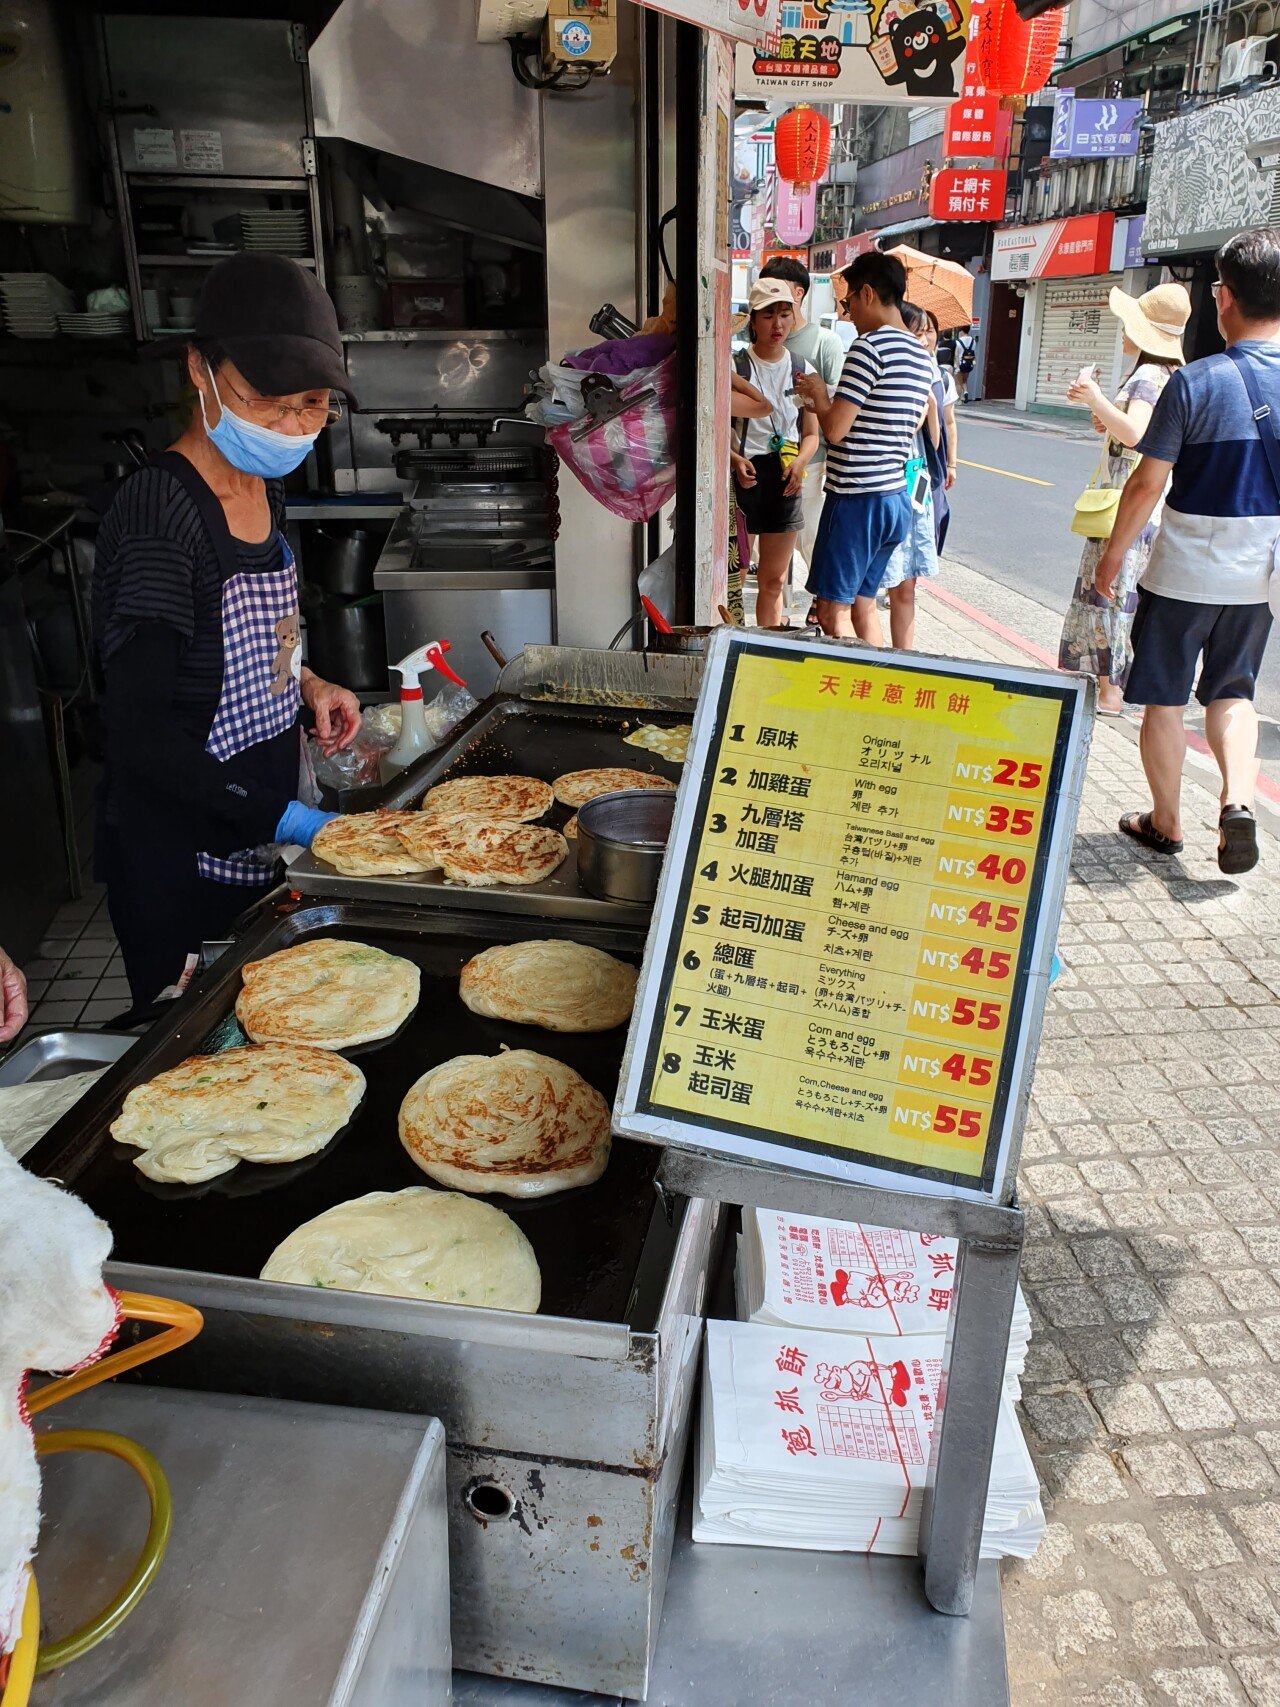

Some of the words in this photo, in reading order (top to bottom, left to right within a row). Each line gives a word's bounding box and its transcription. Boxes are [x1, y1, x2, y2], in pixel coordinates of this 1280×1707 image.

[803, 120, 818, 170] 人山人海
[950, 177, 992, 194] 上網卡
[949, 196, 990, 212] 預付卡
[818, 674, 971, 715] 天津蔥抓餅
[729, 725, 746, 742] 1
[756, 726, 799, 751] 原味
[862, 735, 901, 749] Original
[858, 757, 903, 774] 오리지널
[955, 758, 1043, 789] NT$25
[719, 767, 738, 787] 2
[747, 768, 812, 798] 加雞蛋
[854, 778, 876, 790] With
[878, 781, 897, 795] egg
[709, 813, 727, 834] 3
[740, 803, 806, 833] 九層塔
[850, 801, 871, 814] 계란
[877, 804, 899, 818] 추가
[948, 805, 1035, 836] NT$35
[735, 827, 779, 854] 加蛋
[846, 822, 884, 836] Taiwanese
[885, 829, 903, 839] Basil
[904, 833, 918, 841] and
[920, 836, 935, 845] egg
[840, 855, 859, 867] 추가
[938, 853, 1027, 885] NT$40
[700, 860, 719, 882] 4
[728, 863, 815, 898] 火腿加蛋
[836, 870, 878, 886] Hamand
[880, 881, 900, 892] egg
[691, 904, 711, 925] 5
[719, 906, 806, 943] 起司加蛋
[828, 915, 866, 932] Cheese
[868, 924, 888, 935] and
[890, 929, 909, 941] egg
[930, 900, 1021, 933] NT$45
[683, 950, 701, 971] 6
[712, 942, 757, 970] 總匯
[922, 946, 1012, 979] NT$45
[819, 963, 866, 982] Everything
[706, 982, 732, 998] 火腿)
[673, 1003, 691, 1027] 7
[700, 1007, 766, 1041] 玉米蛋
[913, 997, 1002, 1031] NT$55
[808, 1022, 833, 1036] Corn
[834, 1028, 854, 1041] and
[856, 1034, 876, 1046] egg
[662, 1052, 682, 1074] 8
[692, 1044, 737, 1071] 玉米
[903, 1053, 994, 1086] NT$45
[688, 1070, 754, 1106] 起司蛋
[851, 1087, 867, 1097] and
[868, 1091, 884, 1102] egg
[894, 1104, 982, 1139] NT$55
[774, 1345, 818, 1457] 蔥抓餅
